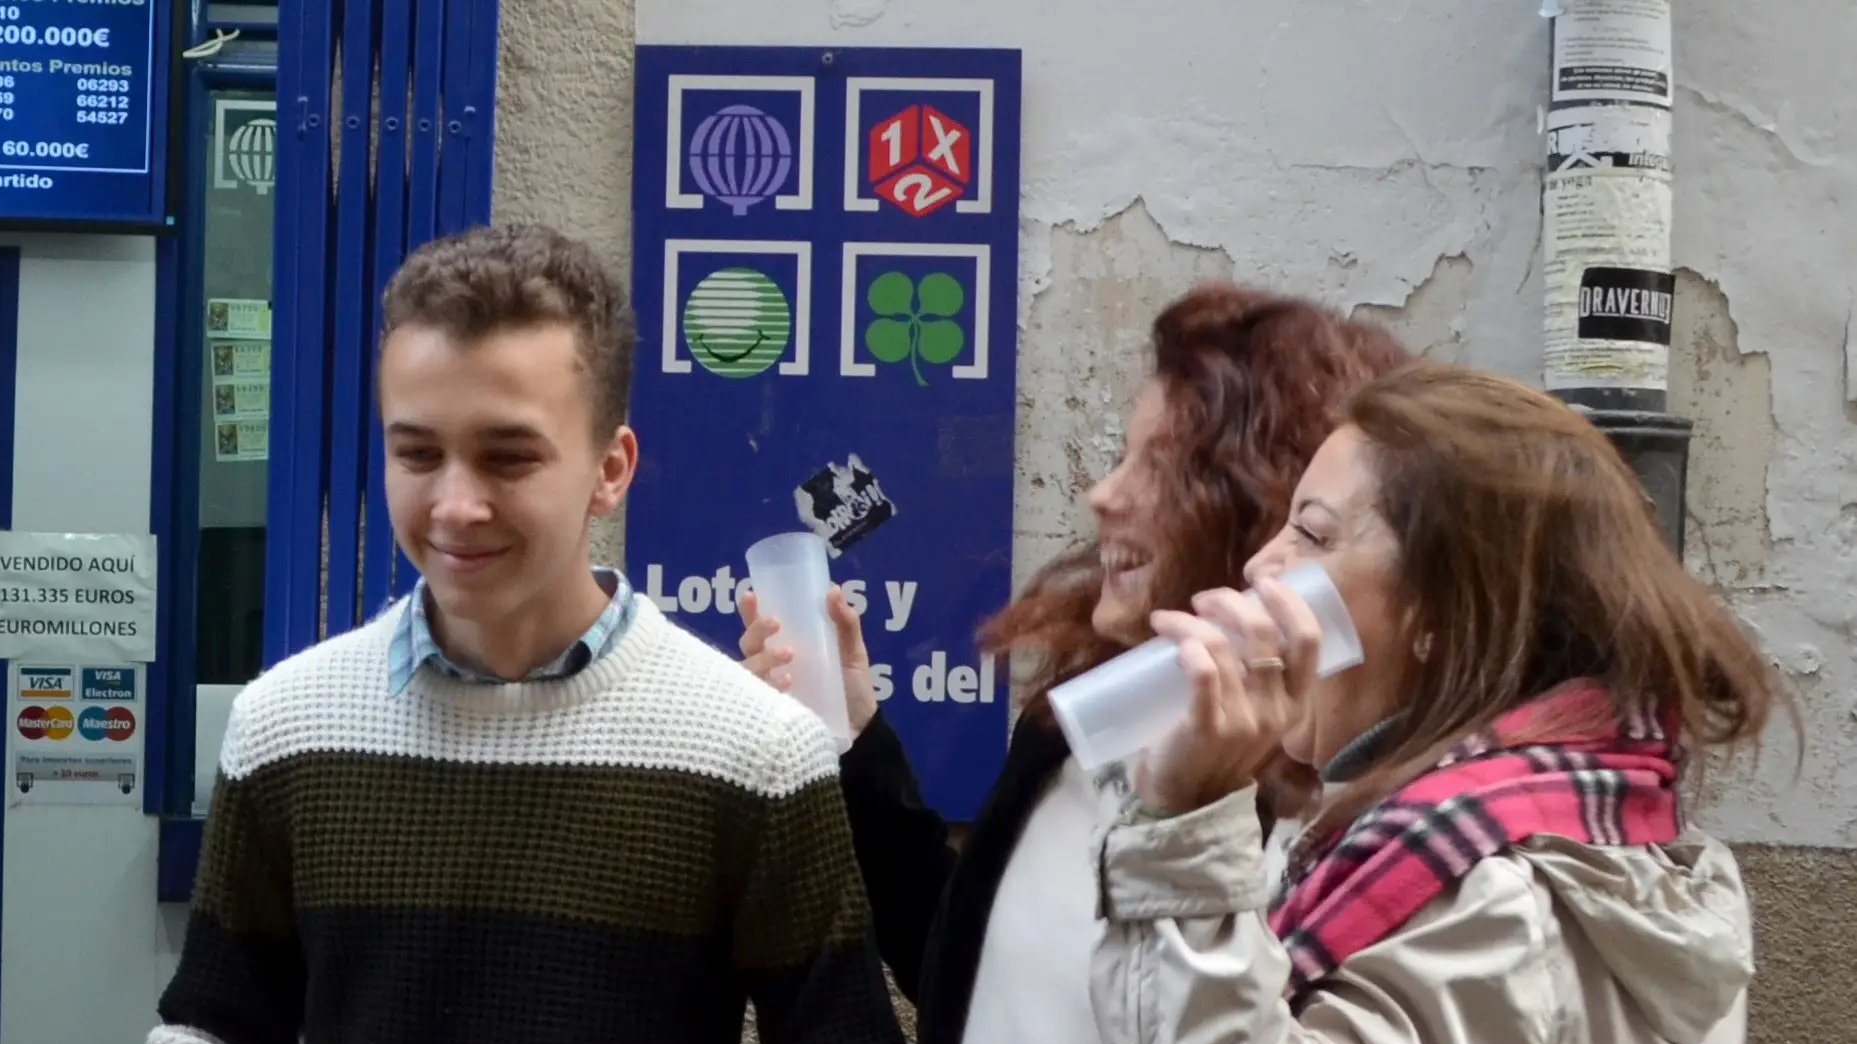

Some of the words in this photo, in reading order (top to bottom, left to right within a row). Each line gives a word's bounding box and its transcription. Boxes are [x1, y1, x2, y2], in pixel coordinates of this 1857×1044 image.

[49, 59, 132, 76] Premios
[76, 78, 129, 92] 06293
[76, 95, 129, 109] 66212
[76, 110, 129, 125] 54527
[2, 140, 90, 159] 60.000€
[0, 555, 83, 572] VENDIDO
[88, 554, 137, 574] AQUÍ
[0, 587, 70, 604] 131.335
[74, 588, 135, 605] EUROS
[884, 580, 918, 632] y
[28, 676, 64, 690] VISA
[94, 670, 122, 682] VISA
[912, 650, 996, 704] del
[84, 687, 133, 699] Electron
[18, 717, 73, 730] MasterCard
[82, 717, 132, 730] Maestro
